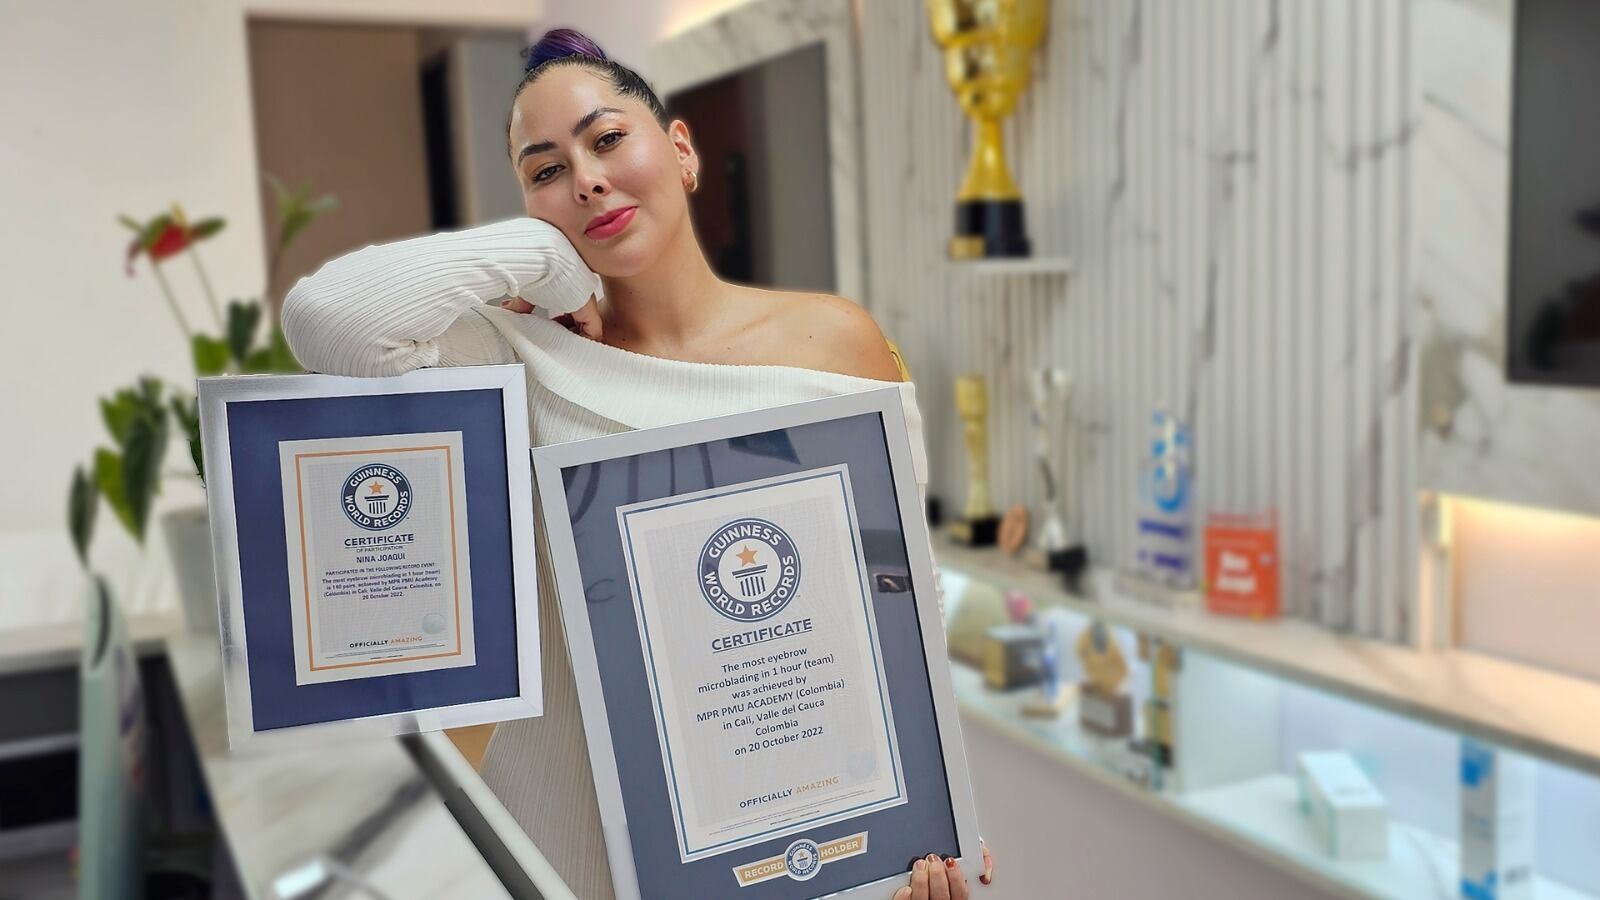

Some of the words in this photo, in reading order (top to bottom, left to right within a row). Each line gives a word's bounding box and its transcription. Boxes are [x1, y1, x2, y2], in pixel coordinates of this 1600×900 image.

[350, 468, 402, 487] GUINNESS
[345, 494, 370, 526] WORLD
[374, 490, 408, 527] RECORDS
[344, 533, 414, 546] CERTIFICATE
[364, 545, 403, 553] PARTICIPATION
[709, 525, 782, 558] GUINNESS
[356, 555, 376, 564] NINA
[378, 553, 405, 562] JOAQUI
[704, 571, 745, 615] WORLD
[751, 555, 795, 616] RECORDS
[349, 640, 389, 649] OFFICIALLY
[390, 635, 423, 644] AMAZING
[712, 618, 813, 650] CERTIFICATE
[698, 672, 760, 694] microblading
[761, 670, 770, 679] in
[772, 667, 778, 676] 1
[780, 662, 802, 674] hour
[804, 653, 834, 670] (team)
[721, 664, 740, 674] The
[742, 656, 765, 669] most
[767, 647, 807, 664] eyebrow
[697, 709, 720, 722] MPR
[721, 703, 744, 716] PMU
[747, 691, 793, 710] ACADEMY
[795, 678, 845, 700] (Colombia)
[731, 689, 751, 700] was
[753, 678, 793, 695] achieved
[795, 675, 807, 686] by
[722, 721, 732, 730] in
[734, 715, 755, 728] Cali,
[756, 709, 780, 722] Valle
[781, 704, 796, 715] del
[797, 699, 825, 712] Cauca
[755, 718, 799, 736] Colombia
[734, 746, 747, 756] on
[748, 742, 760, 752] 20
[762, 733, 800, 748] October
[801, 726, 824, 739] 2022
[739, 788, 793, 809] OFFICIALLY
[796, 776, 839, 794] AMAZING
[744, 861, 784, 879] RECORD
[820, 840, 859, 858] HOLDER
[788, 860, 802, 875] WORLD
[802, 853, 818, 876] RECORDS
[789, 844, 813, 857] GUINNESS
